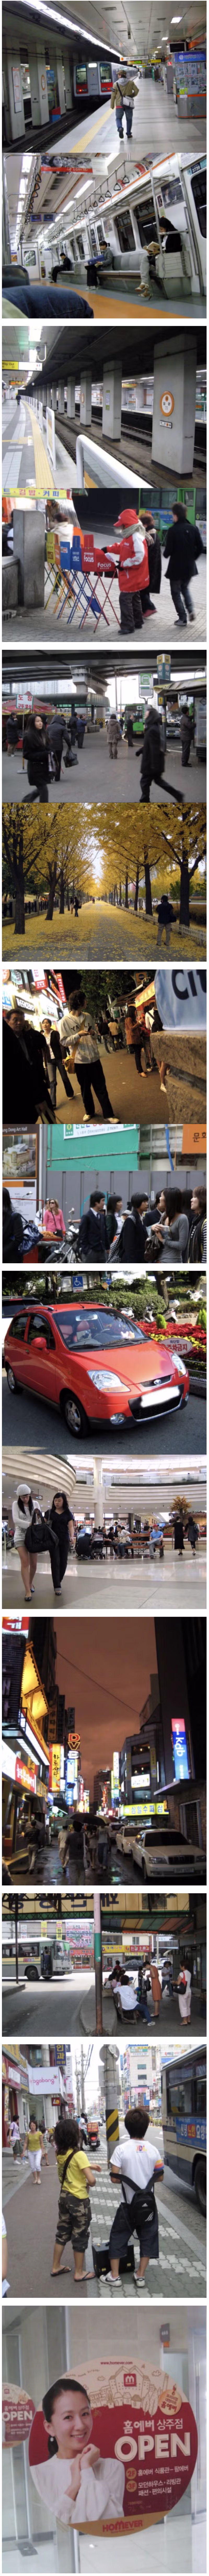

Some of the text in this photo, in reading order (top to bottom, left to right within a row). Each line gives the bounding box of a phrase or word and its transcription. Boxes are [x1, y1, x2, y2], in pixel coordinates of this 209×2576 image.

[71, 1023, 90, 1031] YALE
[68, 1733, 81, 1759] DVD
[175, 1737, 185, 1757] kdb
[131, 1805, 154, 1814] 삼일수피
[161, 2401, 177, 2412] 홈에버
[2, 2410, 32, 2421] OPEN
[123, 2418, 183, 2434] 홈에버 상주점
[114, 2432, 190, 2462] OPEN
